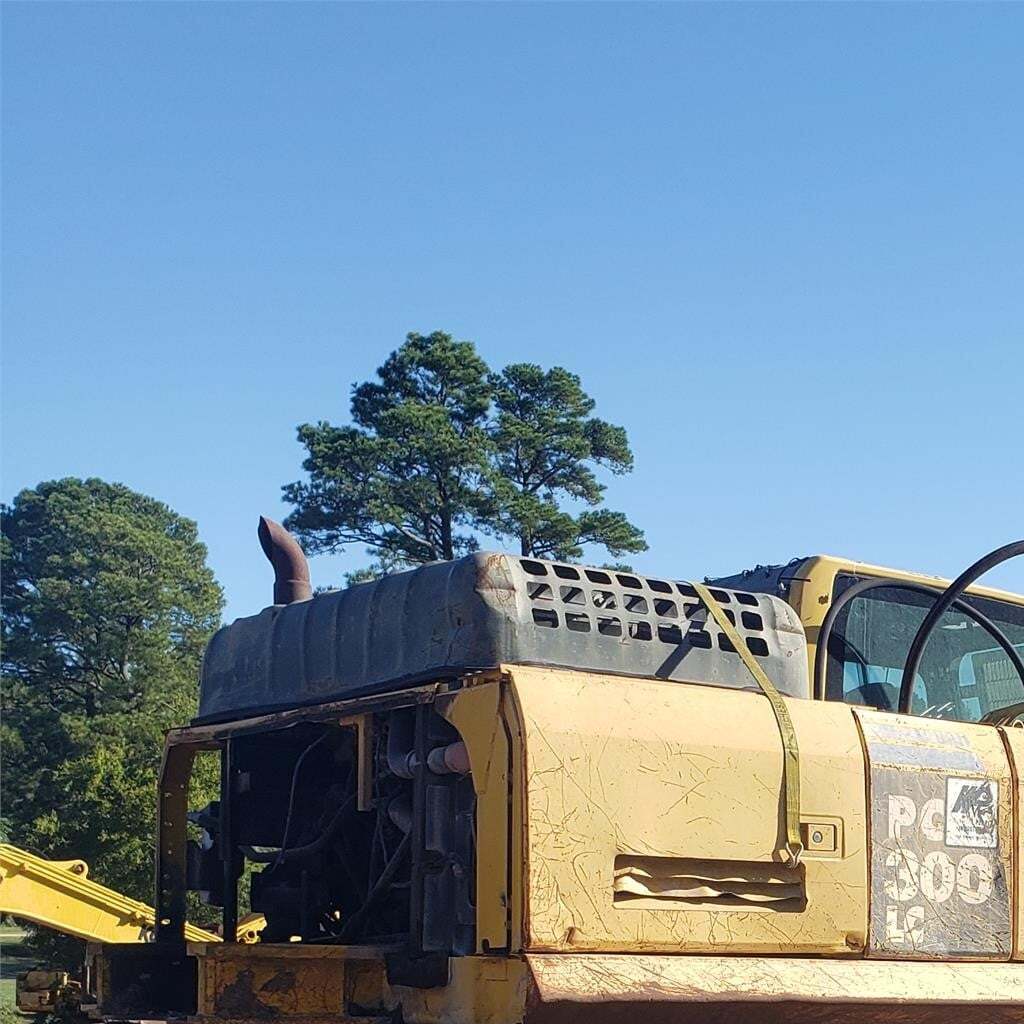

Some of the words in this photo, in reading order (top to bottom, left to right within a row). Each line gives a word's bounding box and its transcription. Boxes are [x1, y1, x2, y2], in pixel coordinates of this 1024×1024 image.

[889, 795, 945, 841] PC
[884, 850, 993, 904] 300
[886, 906, 924, 943] LC
